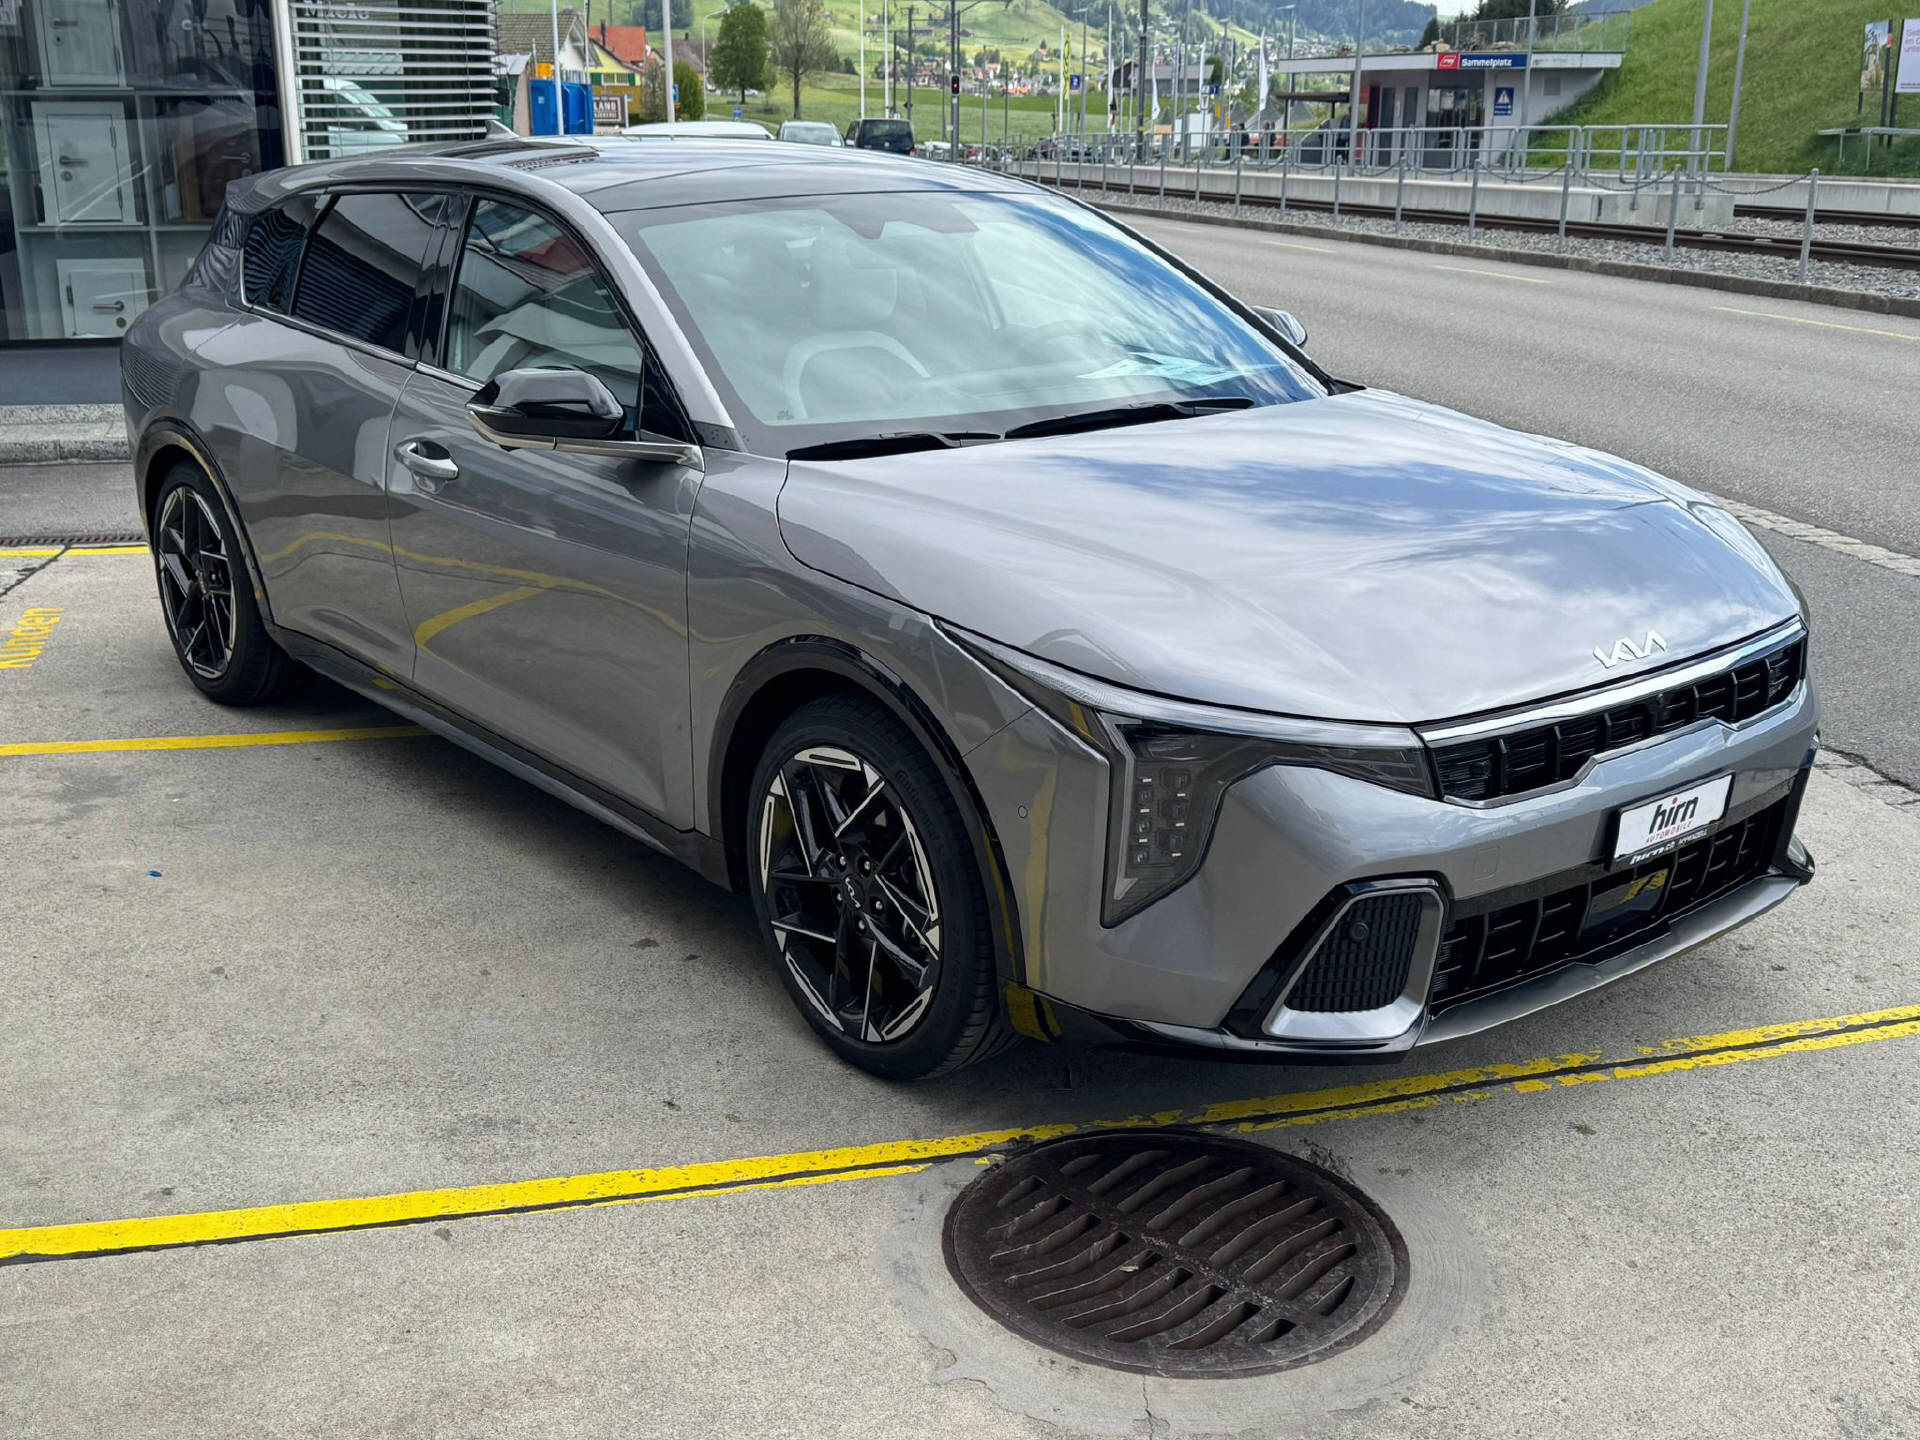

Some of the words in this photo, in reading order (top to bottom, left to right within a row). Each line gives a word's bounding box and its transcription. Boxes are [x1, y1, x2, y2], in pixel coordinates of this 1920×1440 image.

[1461, 58, 1512, 68] Sammelplatz
[1593, 630, 1667, 669] KIA
[1648, 797, 1698, 835] hirn
[1646, 821, 1692, 843] AUTOMOBILE
